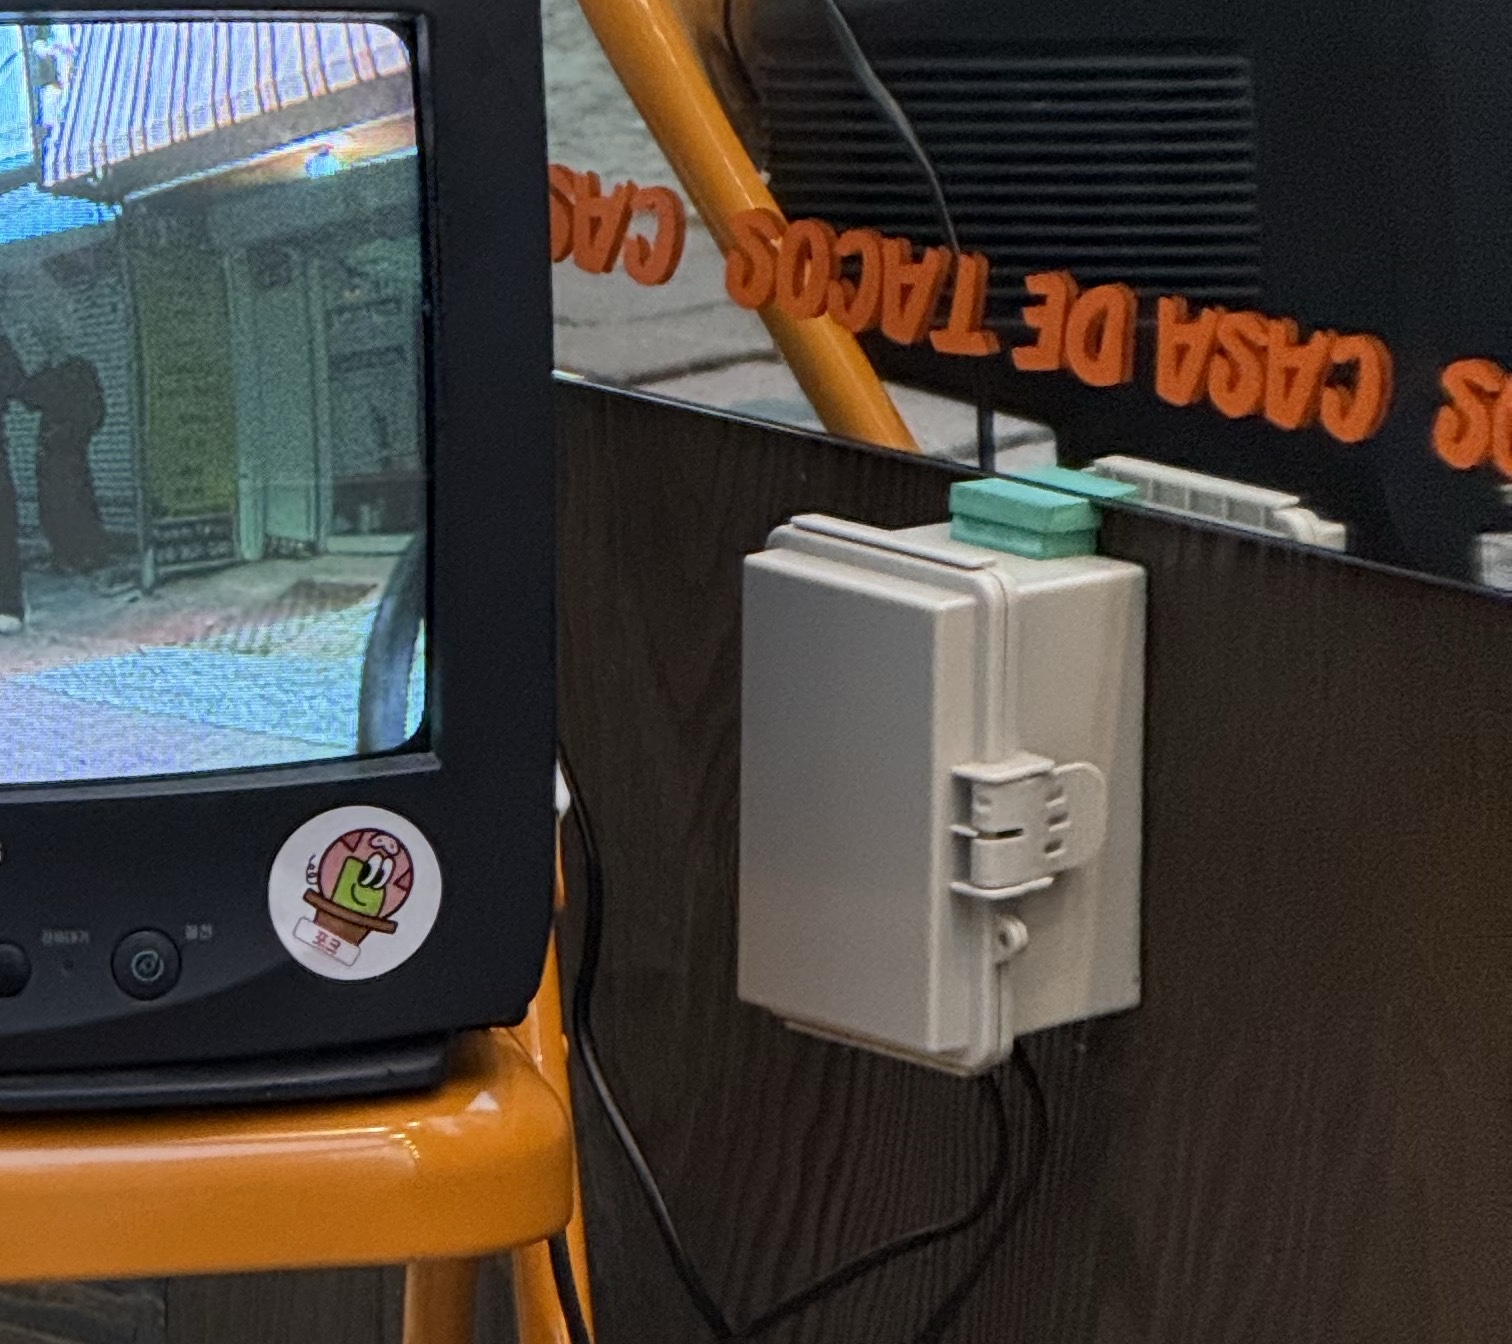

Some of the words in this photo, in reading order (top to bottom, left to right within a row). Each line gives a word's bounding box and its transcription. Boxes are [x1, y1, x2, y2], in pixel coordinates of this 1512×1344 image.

[724, 207, 1003, 357] TACOS
[1011, 269, 1140, 388] DE
[1155, 293, 1395, 444] CASA
